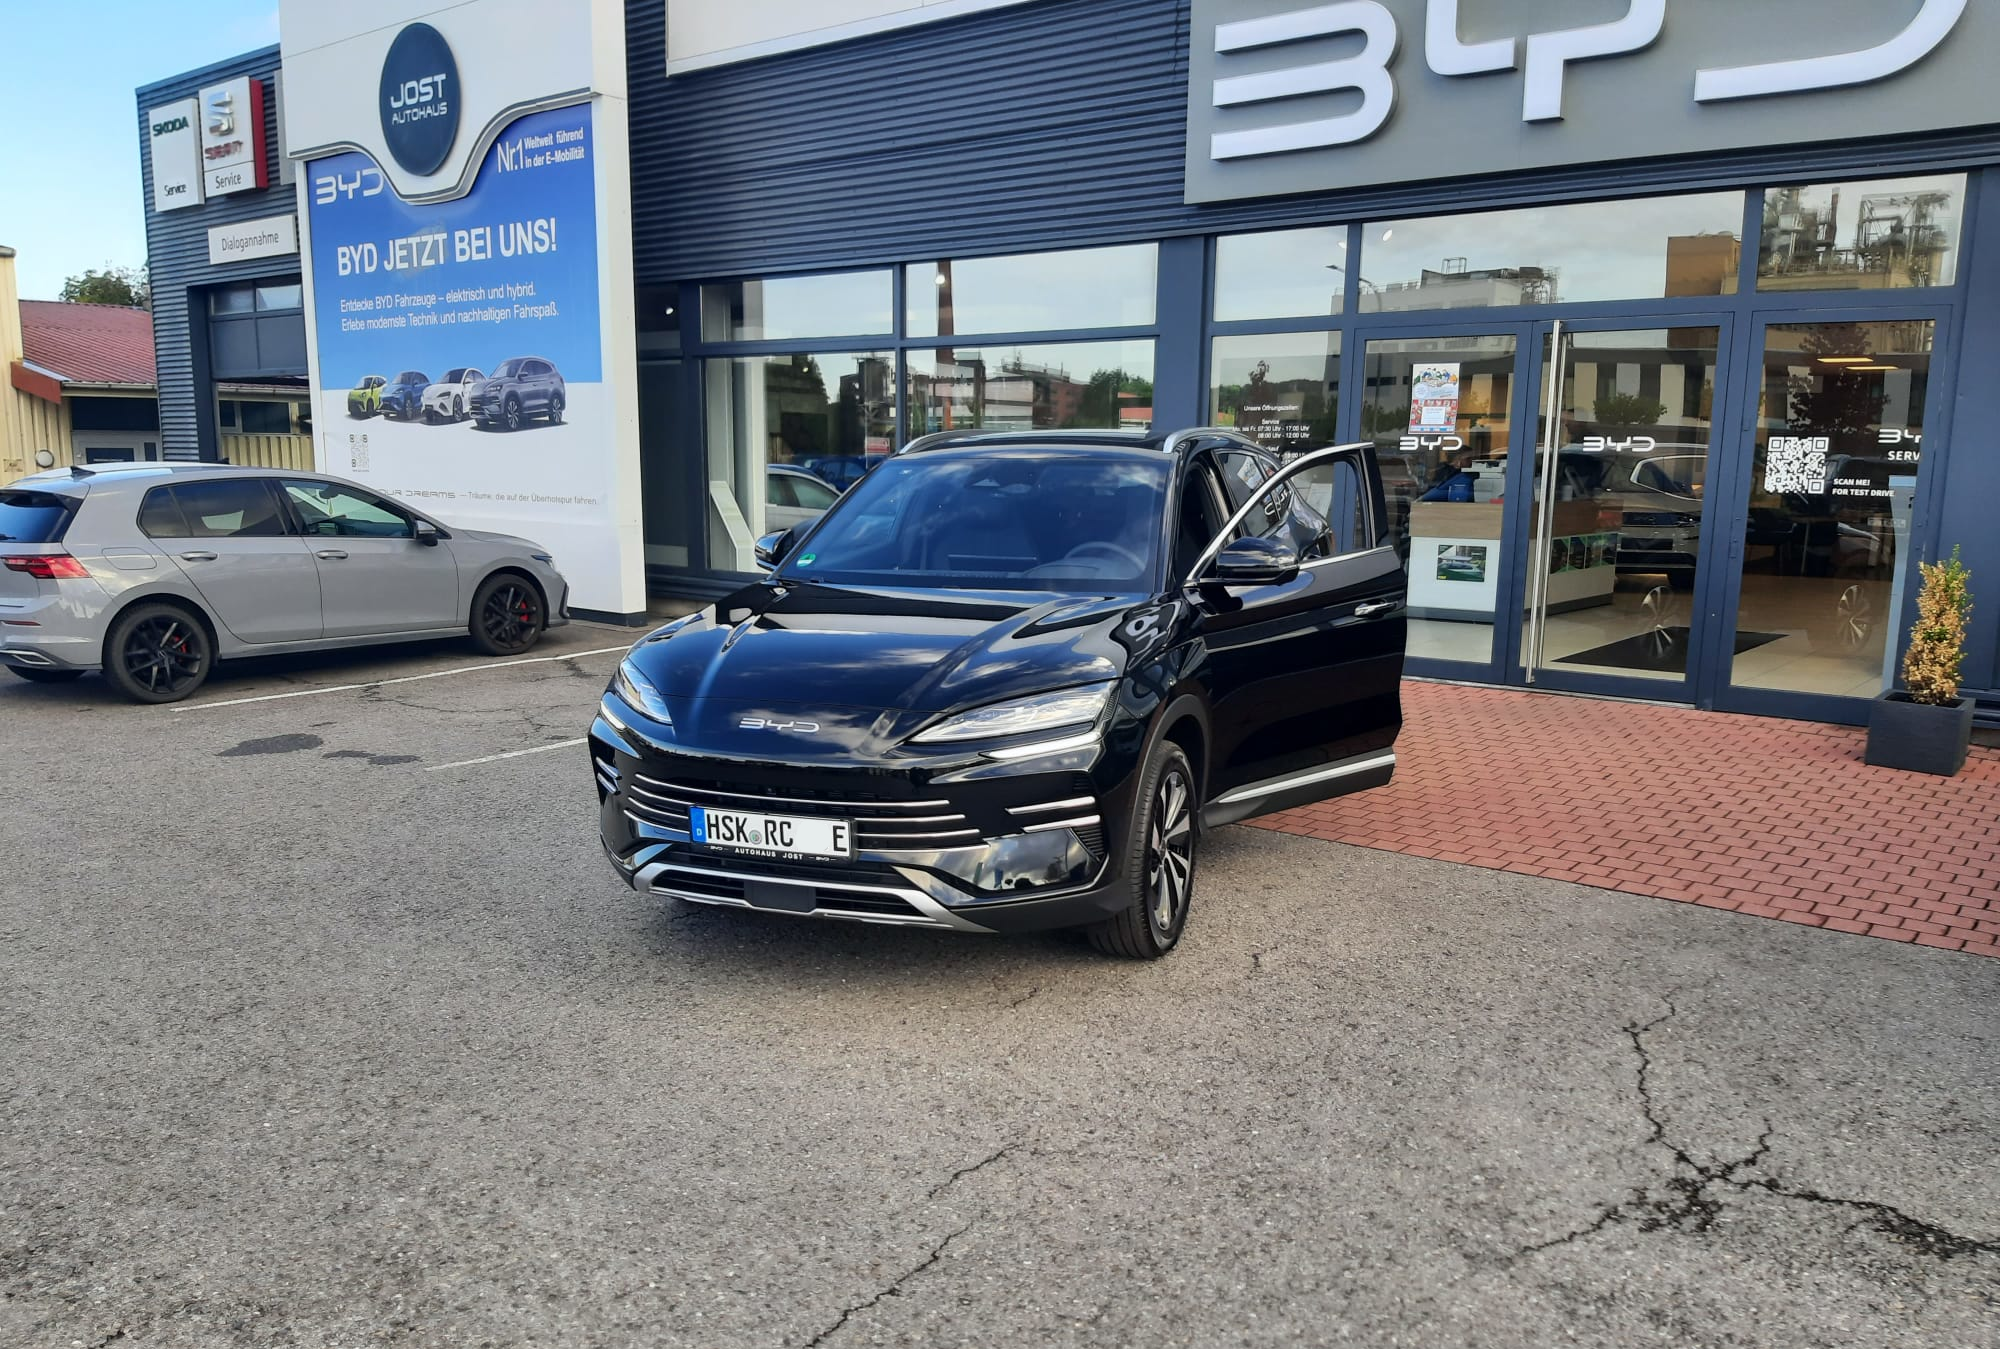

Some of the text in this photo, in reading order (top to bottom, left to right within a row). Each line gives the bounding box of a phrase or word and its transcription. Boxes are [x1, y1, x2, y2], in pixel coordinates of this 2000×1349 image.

[390, 73, 446, 109] JOST
[391, 101, 448, 126] AUTOHAUS
[497, 127, 584, 173] Nr.1 Weltweit führend
[525, 147, 585, 168] in der E-Mobilität
[215, 172, 242, 189] Service
[315, 168, 384, 205] BYD
[164, 183, 187, 197] Service
[221, 231, 279, 252] Dialogannahme
[337, 217, 557, 276] BYD JETZT BEI UNS!
[340, 297, 374, 313] Entdecke
[375, 295, 393, 309] BYD
[395, 292, 436, 308] Fahrzeuge
[446, 286, 485, 303] elektrisch
[488, 284, 504, 300] und
[506, 281, 536, 299] hybrid.
[341, 301, 559, 332] Erlebe modernste Technik und nachhaltigen Fahrspaß.
[1399, 436, 1463, 451] BYD
[1582, 436, 1656, 452] BYD
[1878, 428, 1922, 444] BY
[1887, 450, 1920, 461] SERV
[1833, 478, 1854, 486] SCAN
[378, 488, 402, 497] OUR
[405, 490, 456, 499] DREAMS
[495, 493, 505, 501] die
[507, 493, 517, 501] auf
[519, 493, 529, 502] der
[531, 492, 572, 504] Überholspur
[1832, 488, 1849, 496] FOR
[1870, 489, 1895, 497] DRIVE
[739, 717, 821, 733] BYD
[706, 813, 847, 852] HSK RC E
[735, 848, 776, 858] AUTOHAUS
[783, 852, 803, 860] JOST
